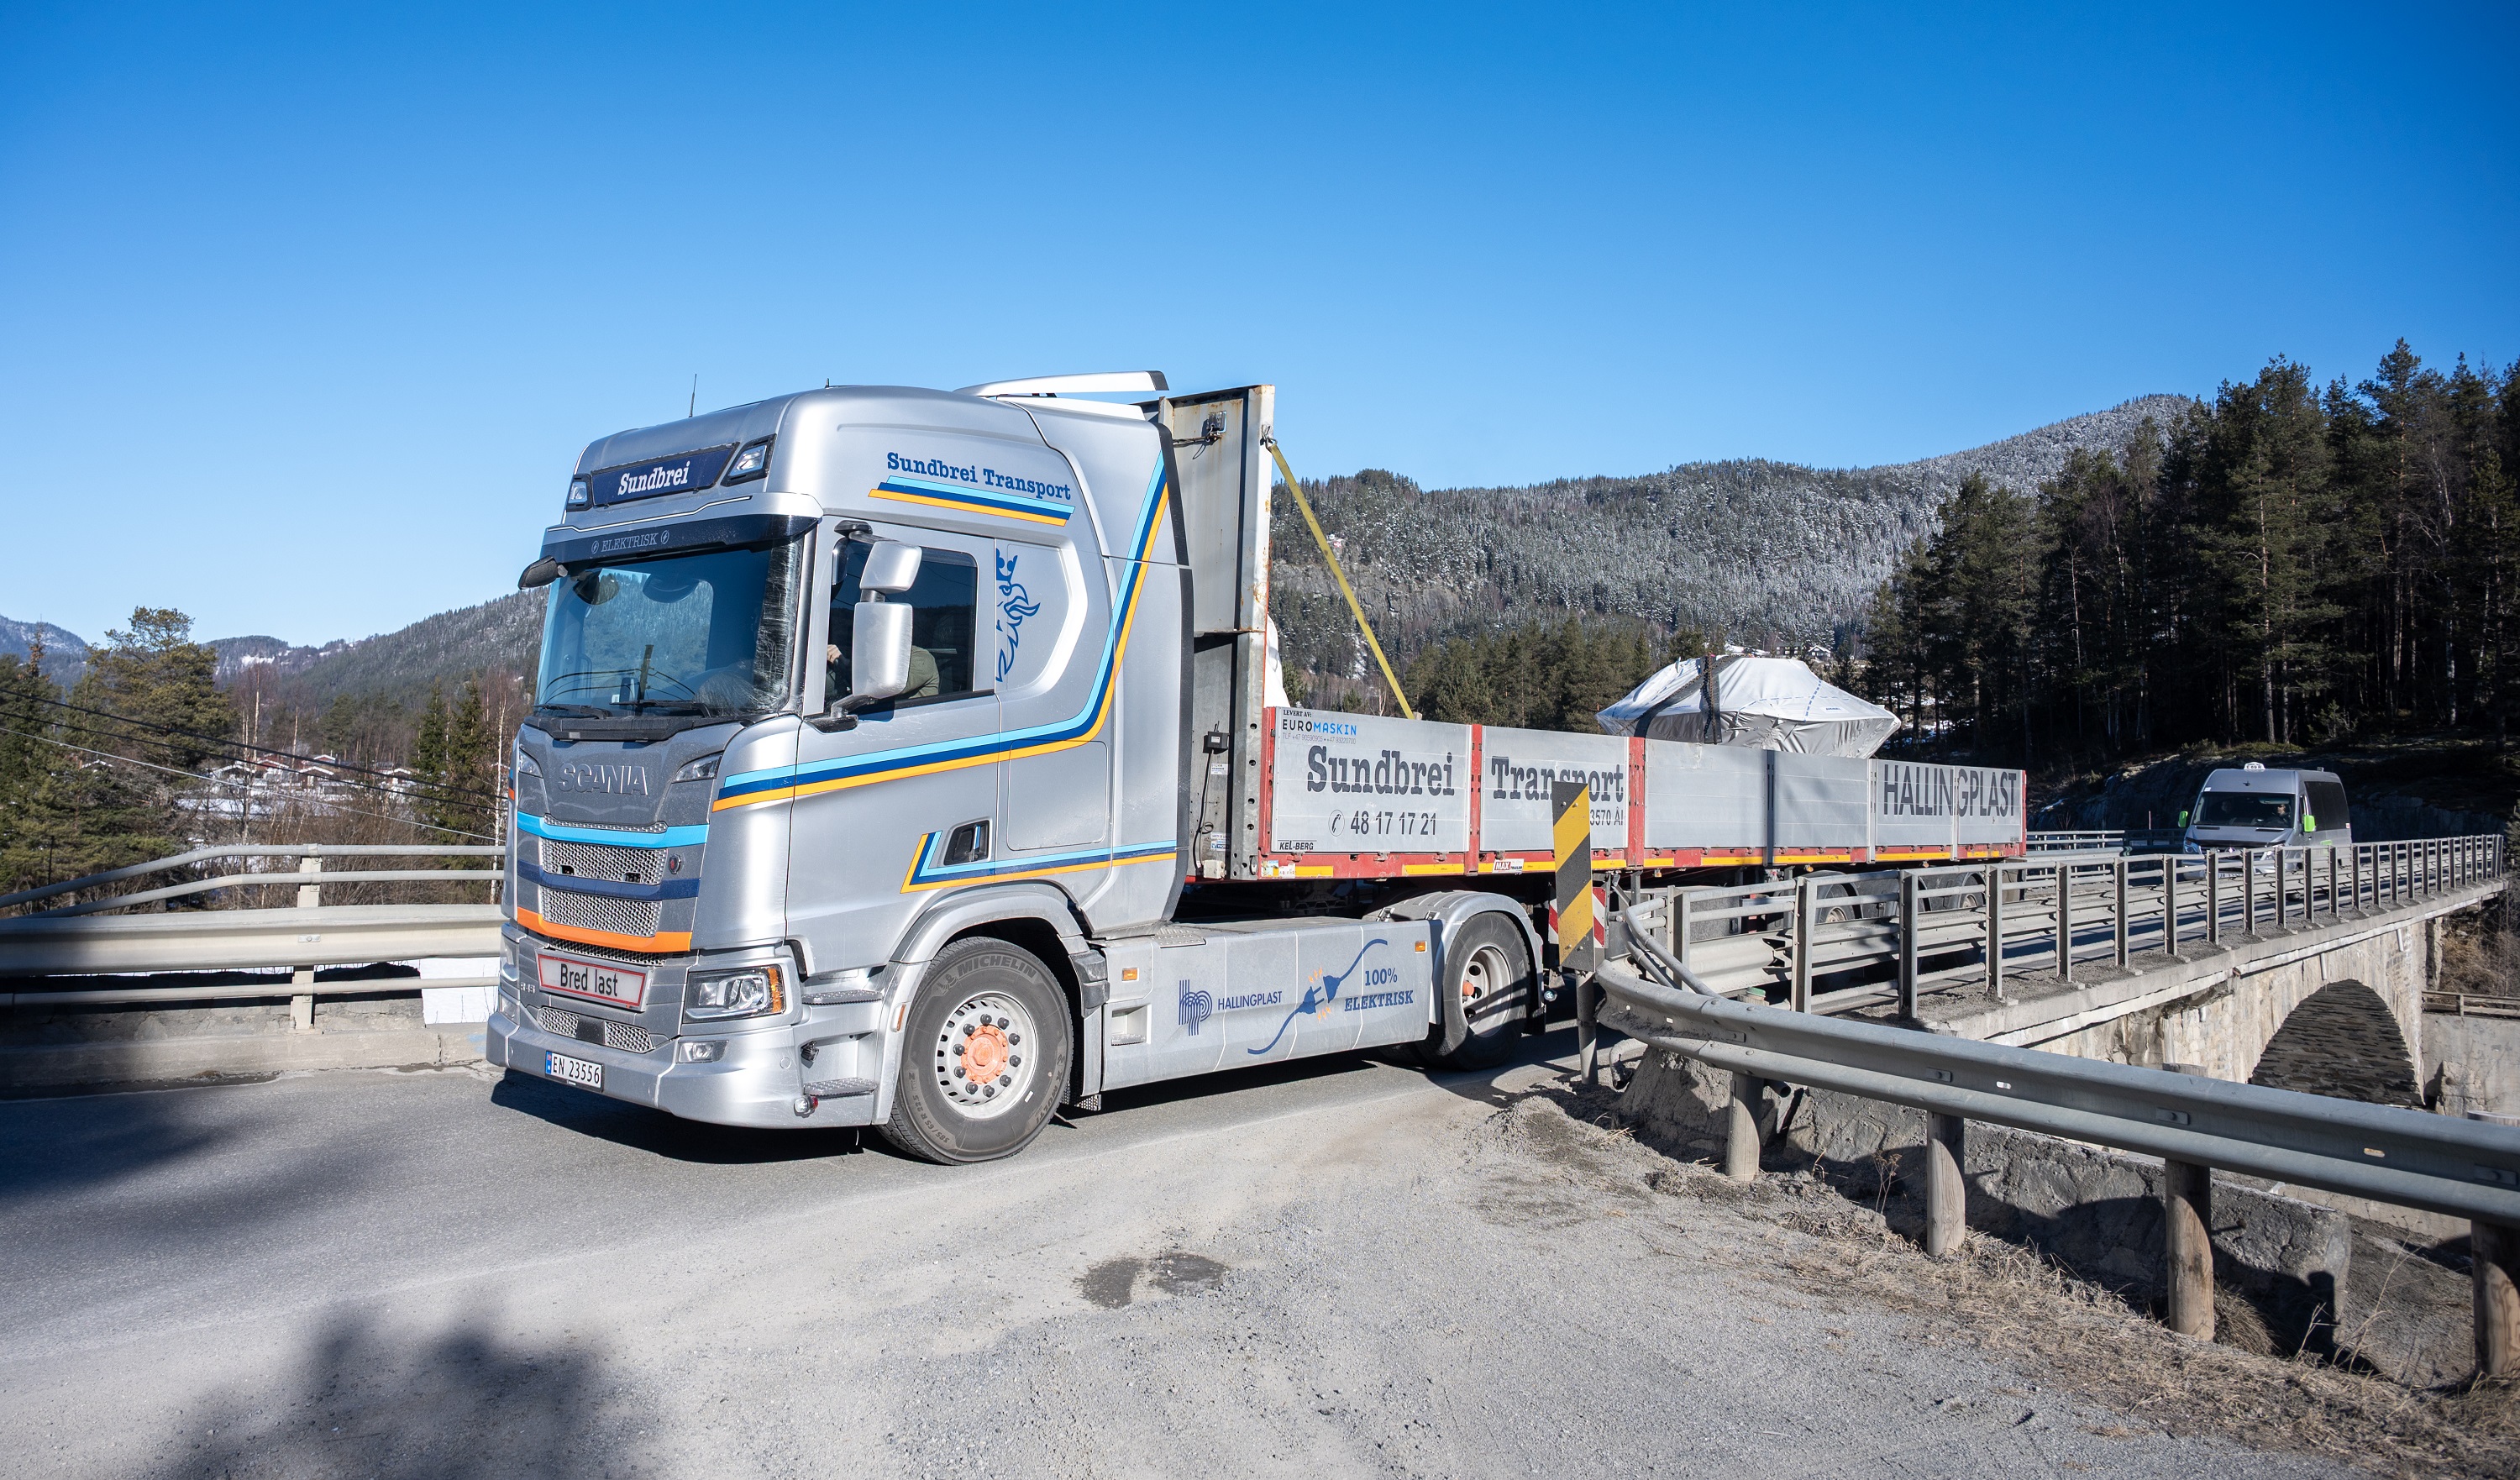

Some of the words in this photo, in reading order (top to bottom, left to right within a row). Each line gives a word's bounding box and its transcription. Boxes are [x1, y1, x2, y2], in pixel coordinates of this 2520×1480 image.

[617, 460, 690, 496] Sundbrei
[887, 452, 978, 483] Sundbrei
[983, 468, 1071, 500] Transport
[601, 533, 659, 553] ELEKTRISK
[1282, 719, 1357, 736] EUROMASKIN
[558, 763, 648, 795] SCANIA
[1307, 745, 1455, 795] Sundbrei
[1883, 764, 2017, 816] HALLINGPLAST
[1350, 811, 1370, 835] 48
[1376, 811, 1394, 835] 17
[1399, 812, 1416, 835] 17
[1420, 812, 1436, 836] 21
[1589, 809, 1611, 826] 3570
[1495, 862, 1510, 870] MAX
[957, 955, 1037, 978] MICHELIN
[1364, 968, 1398, 986] 100%
[560, 963, 588, 991] Bred
[595, 968, 618, 996] last
[1217, 991, 1283, 1010] HALLINGPLAST
[1344, 990, 1414, 1011] ELEKTRISK
[553, 1056, 565, 1075] EN
[569, 1060, 600, 1084] 23556
